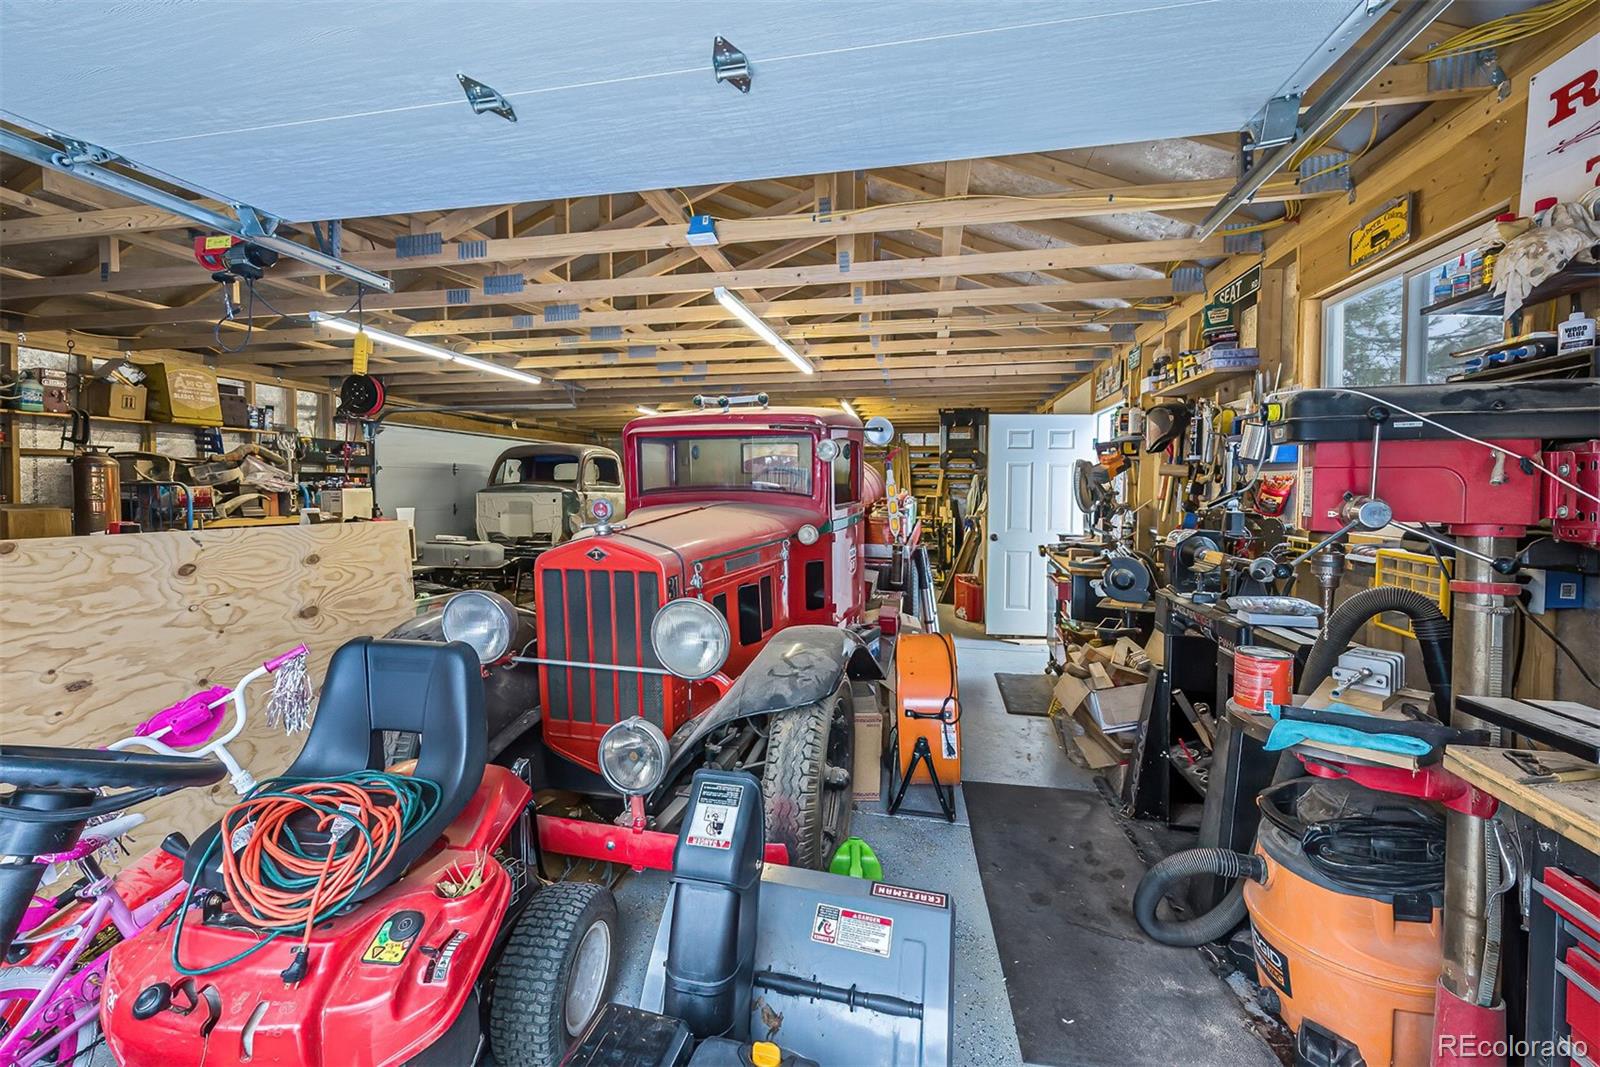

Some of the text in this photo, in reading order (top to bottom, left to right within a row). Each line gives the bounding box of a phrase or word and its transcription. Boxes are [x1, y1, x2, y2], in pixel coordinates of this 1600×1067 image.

[1219, 280, 1243, 304] SEAT
[1565, 325, 1588, 333] WOOD
[1567, 330, 1585, 338] GLUE
[592, 550, 601, 560] T
[878, 887, 941, 904] CRAFTSMAN
